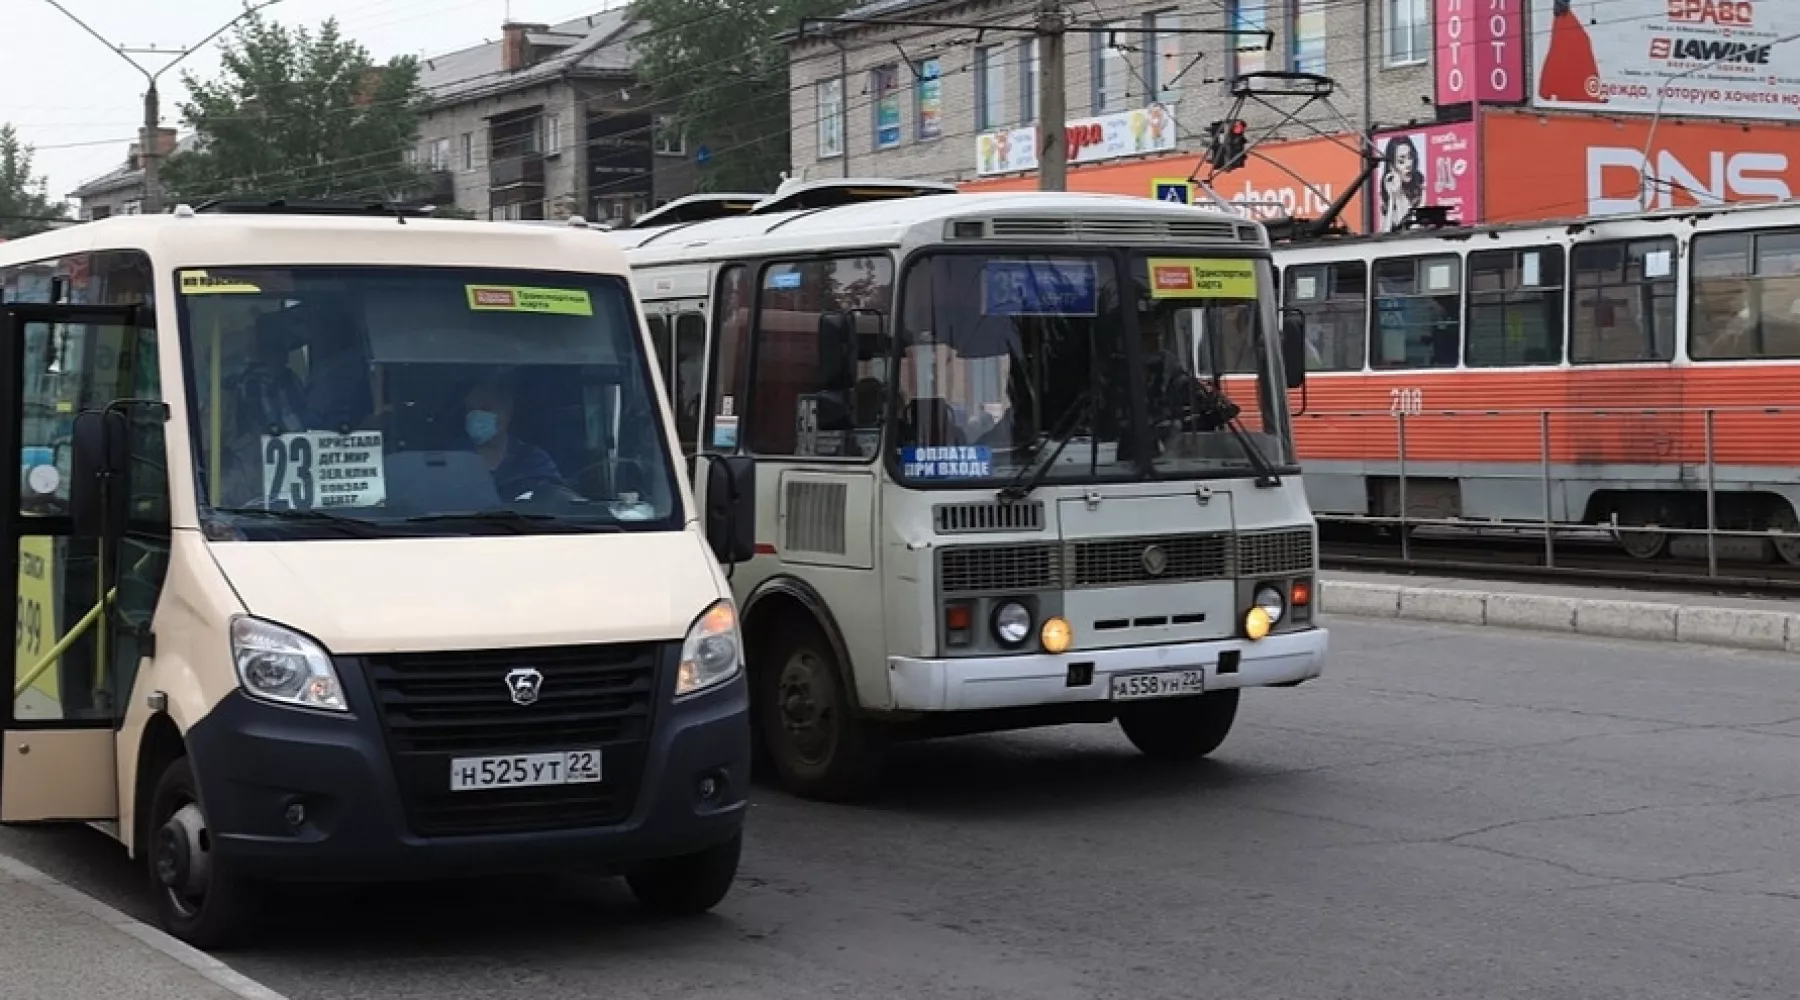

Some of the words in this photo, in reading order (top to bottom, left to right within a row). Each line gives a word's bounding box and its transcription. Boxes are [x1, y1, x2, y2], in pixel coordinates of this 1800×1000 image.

[1673, 39, 1772, 64] LAWINE
[1657, 87, 1721, 104] которую
[1724, 90, 1778, 103] хочется
[1587, 147, 1791, 216] DNS
[1195, 266, 1252, 279] Транспортная
[1390, 387, 1422, 417] 208
[319, 436, 381, 448] КРИСТАЛЛ
[916, 448, 977, 462] ОПЛАТА
[265, 436, 314, 508] 23
[904, 462, 935, 477] ПРИ
[938, 462, 989, 477] ВХОДЕ
[569, 753, 593, 772] 22
